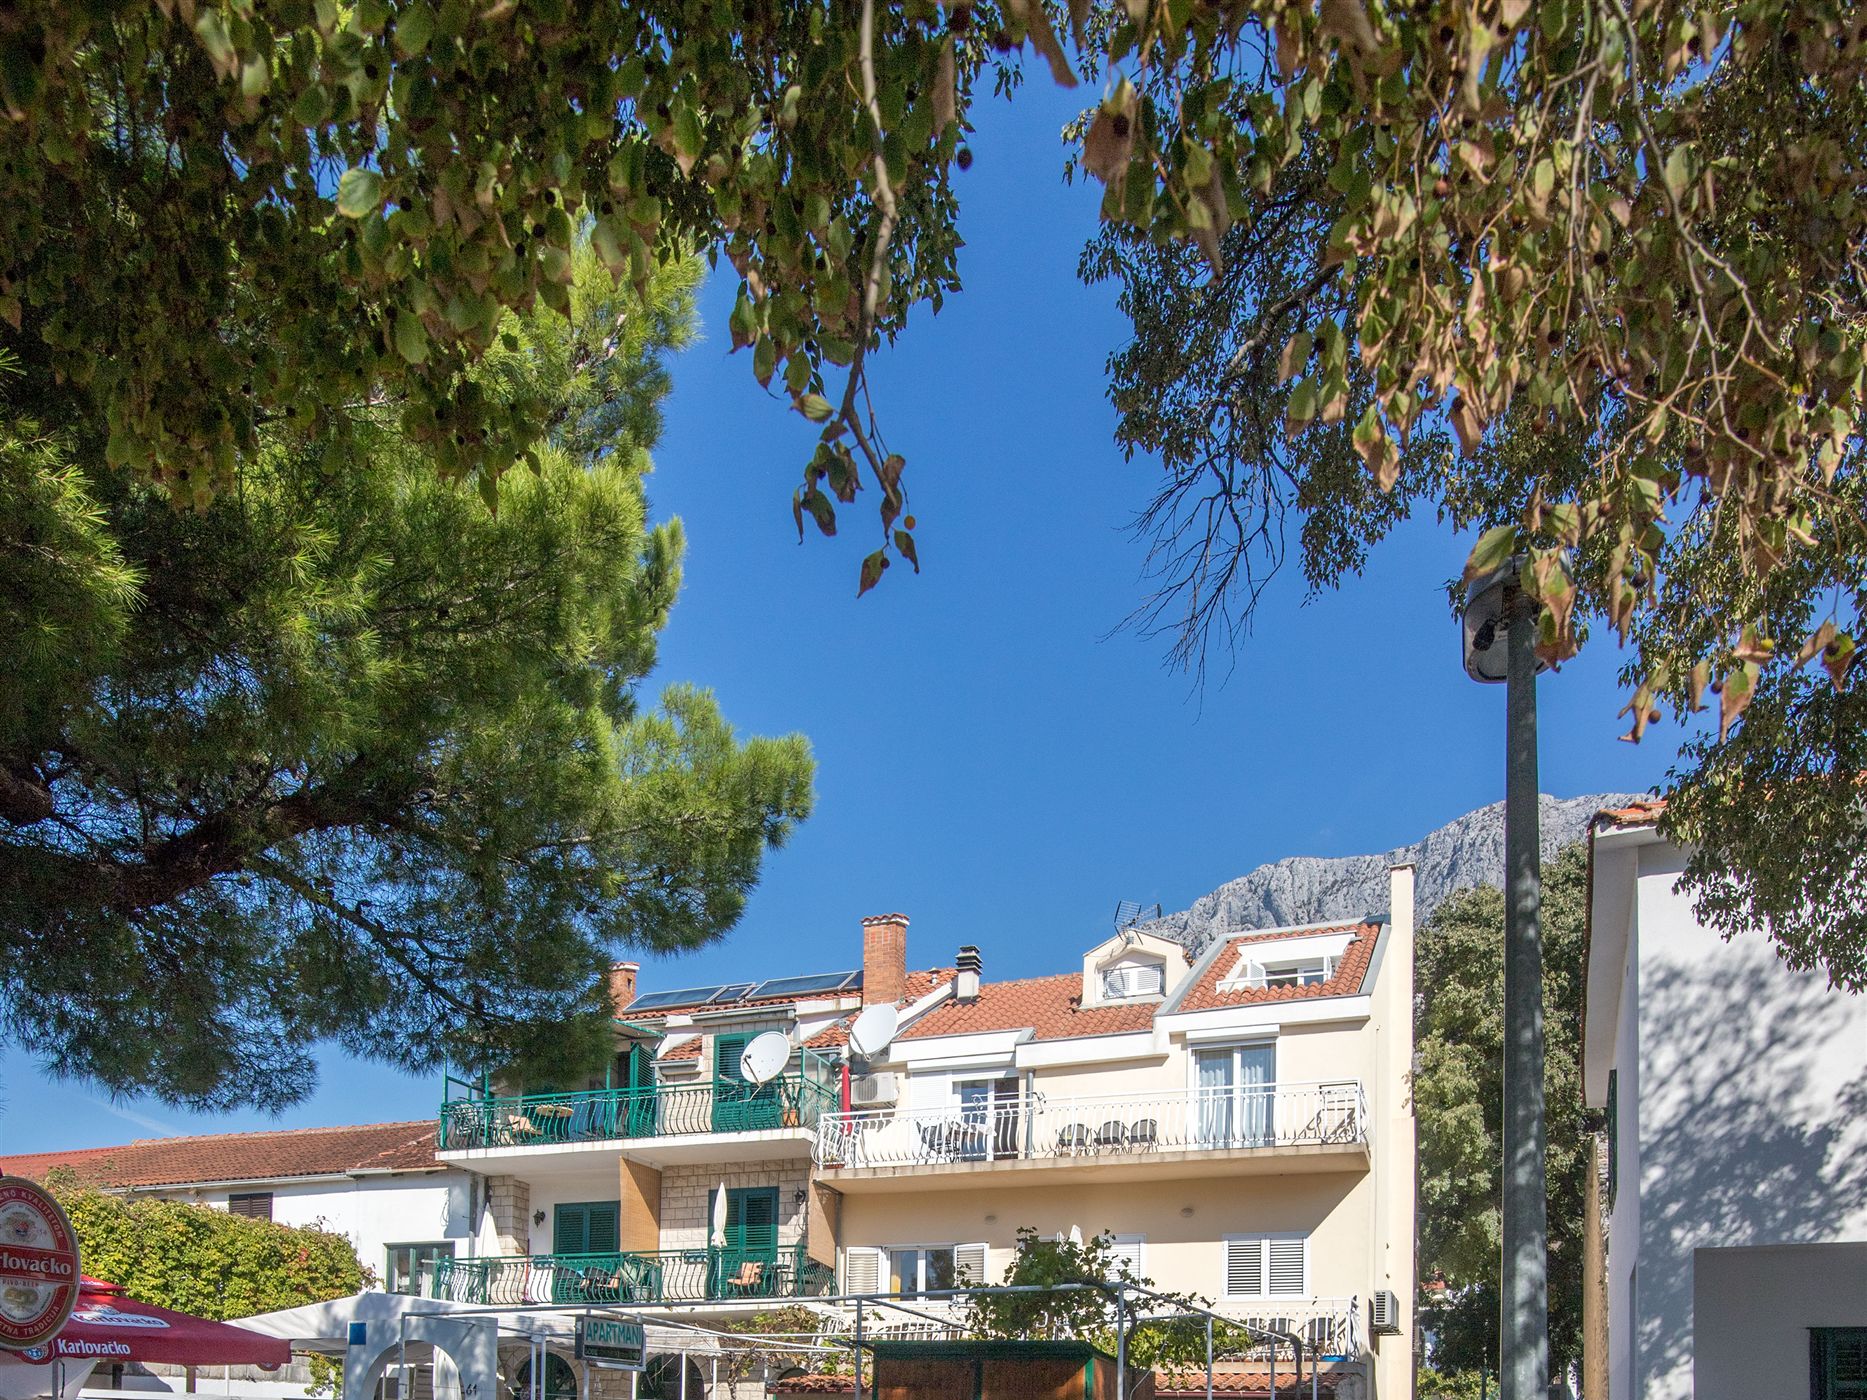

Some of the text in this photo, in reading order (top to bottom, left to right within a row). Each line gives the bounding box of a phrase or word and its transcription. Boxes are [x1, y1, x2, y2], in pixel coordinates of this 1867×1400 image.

[0, 1252, 72, 1275] lovačko
[23, 1306, 60, 1336] TRADICIJA
[586, 1321, 643, 1346] APARTMANI
[57, 1338, 131, 1355] Karlovačko
[466, 1383, 477, 1396] 61
